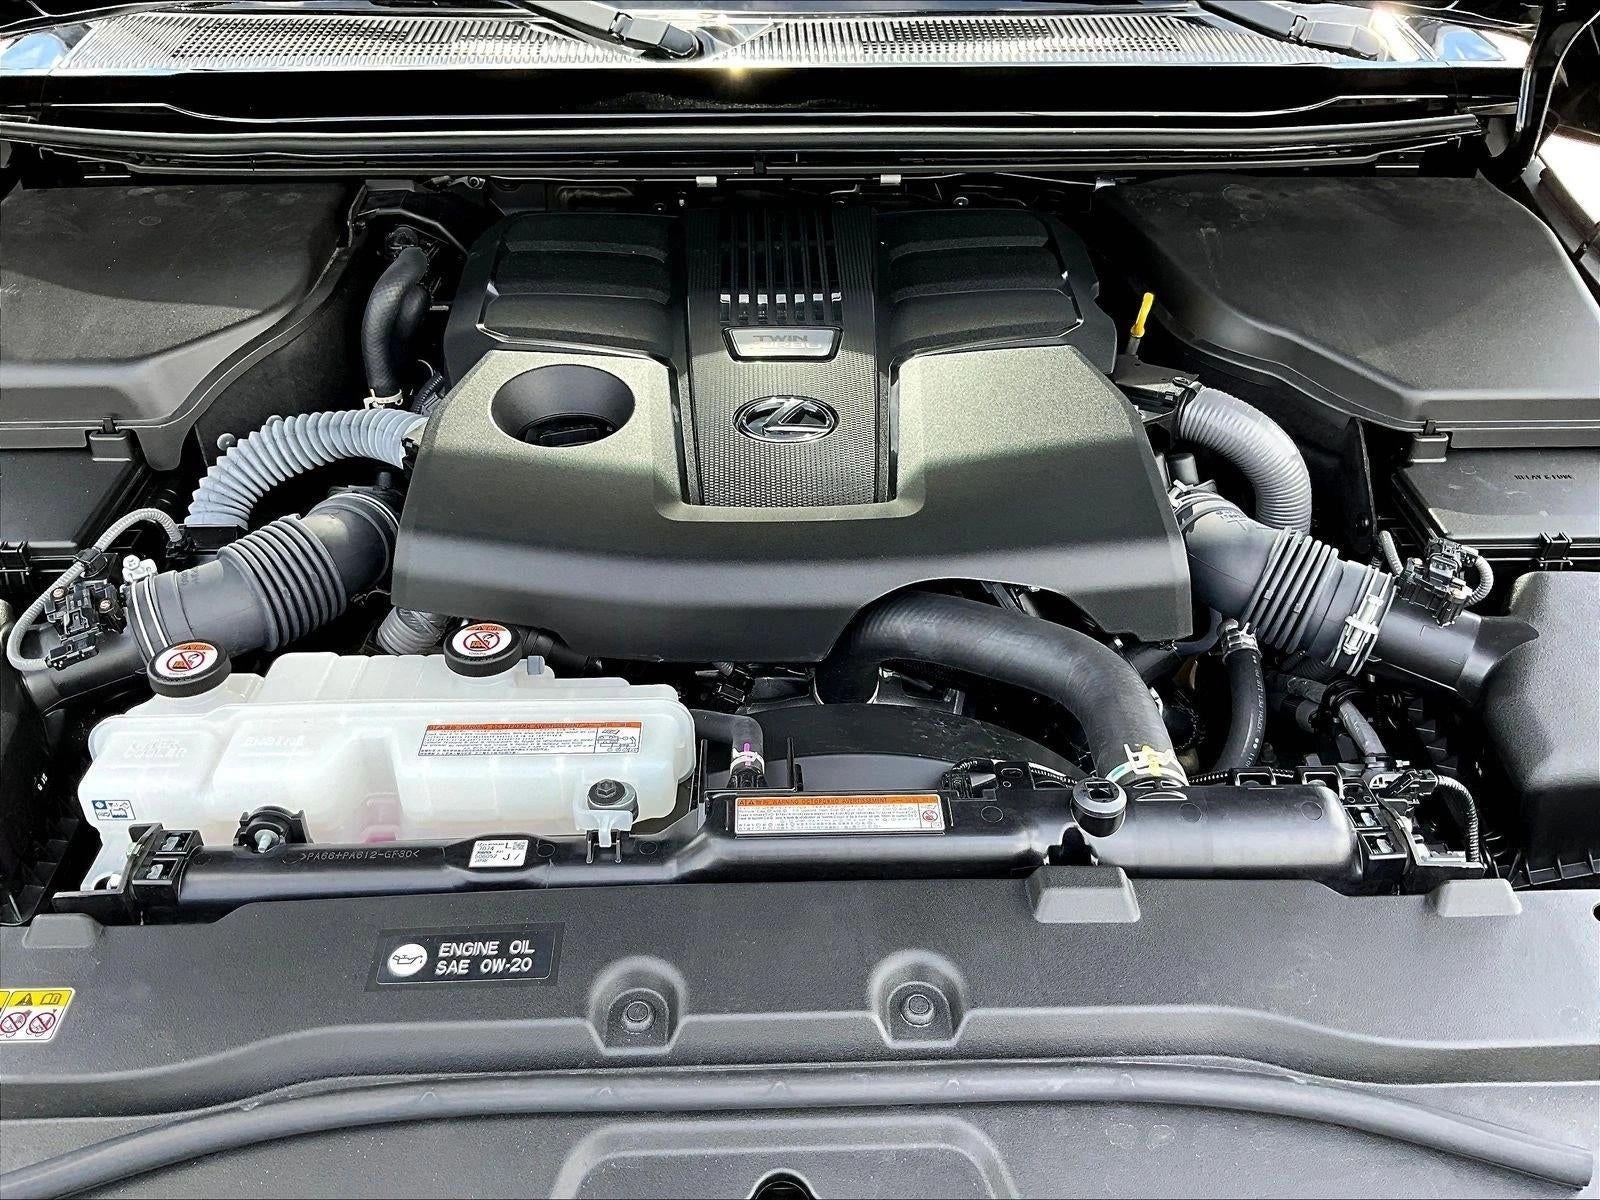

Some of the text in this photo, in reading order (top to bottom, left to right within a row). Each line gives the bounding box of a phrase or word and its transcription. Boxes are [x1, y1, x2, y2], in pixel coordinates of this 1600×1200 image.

[438, 940, 535, 957] ENGINE OIL
[434, 957, 533, 976] SAE 0W-20
